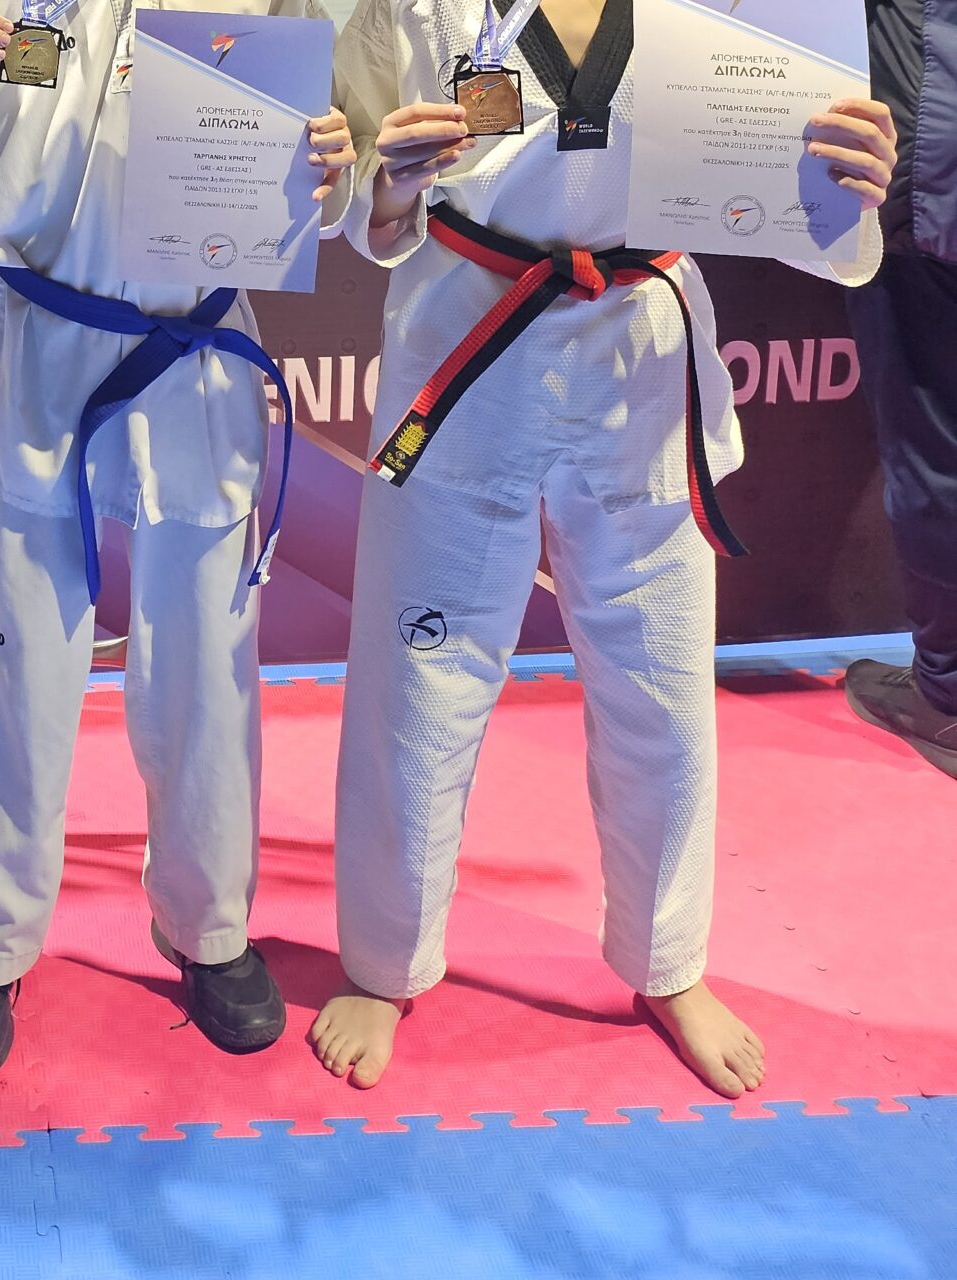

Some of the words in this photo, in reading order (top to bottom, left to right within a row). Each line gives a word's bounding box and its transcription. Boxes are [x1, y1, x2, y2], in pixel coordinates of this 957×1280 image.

[495, 5, 526, 45] TAEKWONDO
[710, 53, 773, 64] ΑΠΟΝΕΜΕΤΑΙ
[776, 57, 790, 65] ΤΟ
[714, 65, 787, 79] ΔΙΠΛΩΜΑ
[815, 92, 832, 100] 2025
[196, 106, 249, 117] ΑΠΟΝΕΜΕΤΑΙ
[252, 109, 264, 117] ΤΟ
[706, 103, 743, 112] ΠΑΛΤΙΔΗΣ
[745, 106, 791, 114] ΕΛΕΥΘΕΡΙΟΣ
[198, 117, 260, 131] ΔΙΠΛΩΜΑ
[749, 119, 777, 127] ΕΔΕΣΣΑΣ
[698, 129, 731, 137] κατέκτησε
[732, 130, 742, 138] 3η
[744, 131, 760, 139] θέση
[730, 142, 757, 150] 2011-12
[194, 153, 227, 161] ΤΑΡΠΑΝΗΣ
[229, 155, 257, 163] ΧΡΗΣΤΟΣ
[702, 158, 745, 166] ΘΕΣΣΑΛΟΝΙΚΗ
[746, 161, 790, 169] 12-14/12/2025
